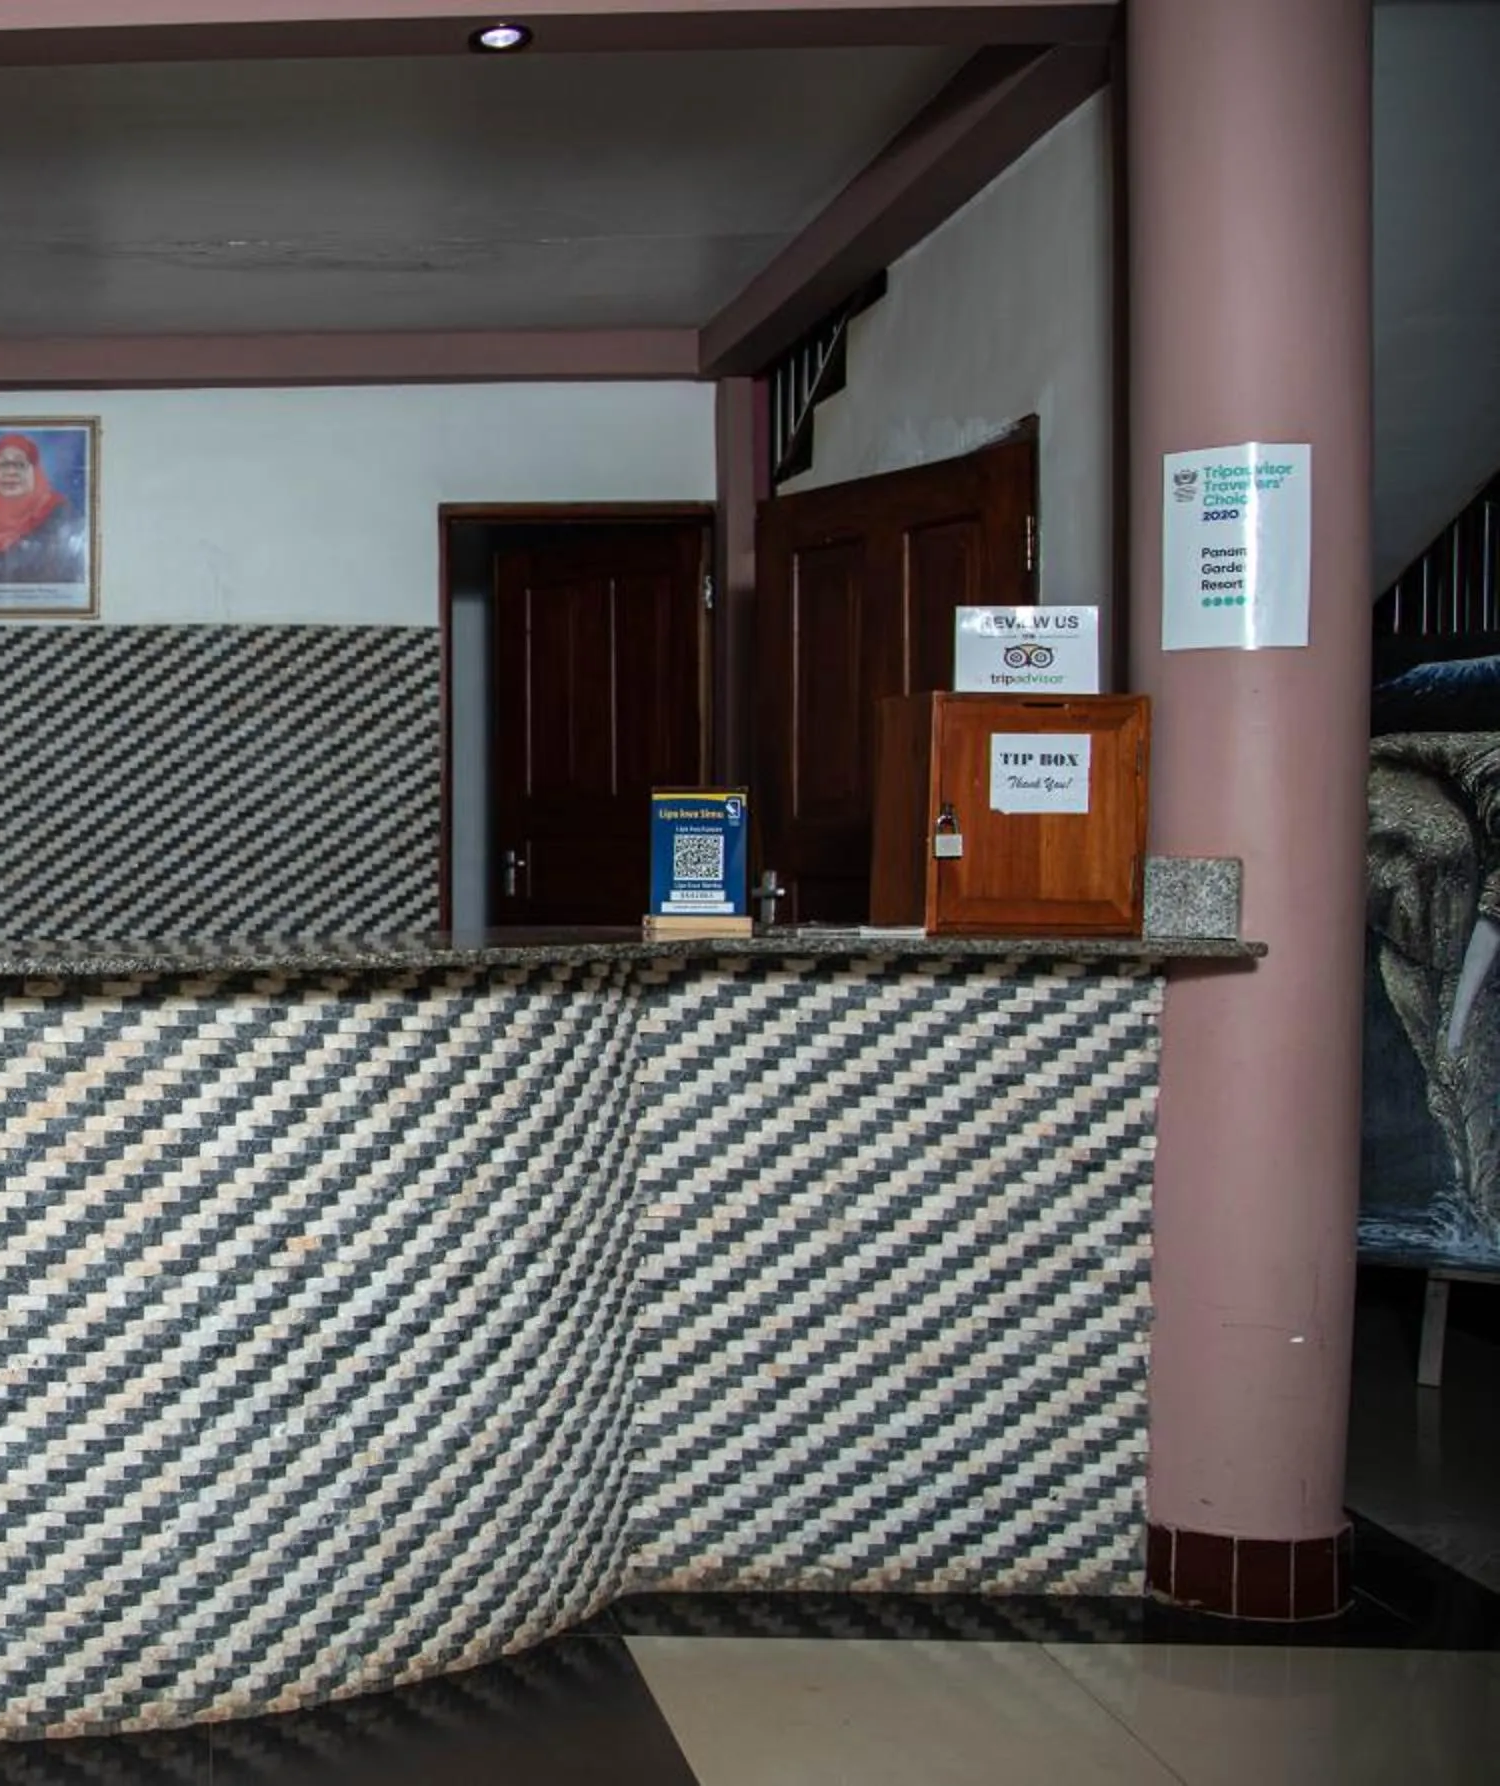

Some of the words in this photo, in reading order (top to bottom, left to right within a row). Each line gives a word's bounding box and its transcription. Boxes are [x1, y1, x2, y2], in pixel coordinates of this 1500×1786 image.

[1203, 493, 1250, 507] Choic
[1202, 508, 1240, 522] 2020
[1201, 547, 1248, 559] Panam
[1201, 561, 1246, 575] Garde
[1201, 579, 1244, 591] Resort
[981, 615, 1050, 629] REVW
[1055, 615, 1080, 629] US
[991, 673, 1065, 686] tripadvisor
[1000, 752, 1034, 766] TIP
[1039, 753, 1080, 767] BOX
[1007, 775, 1042, 789] Thank
